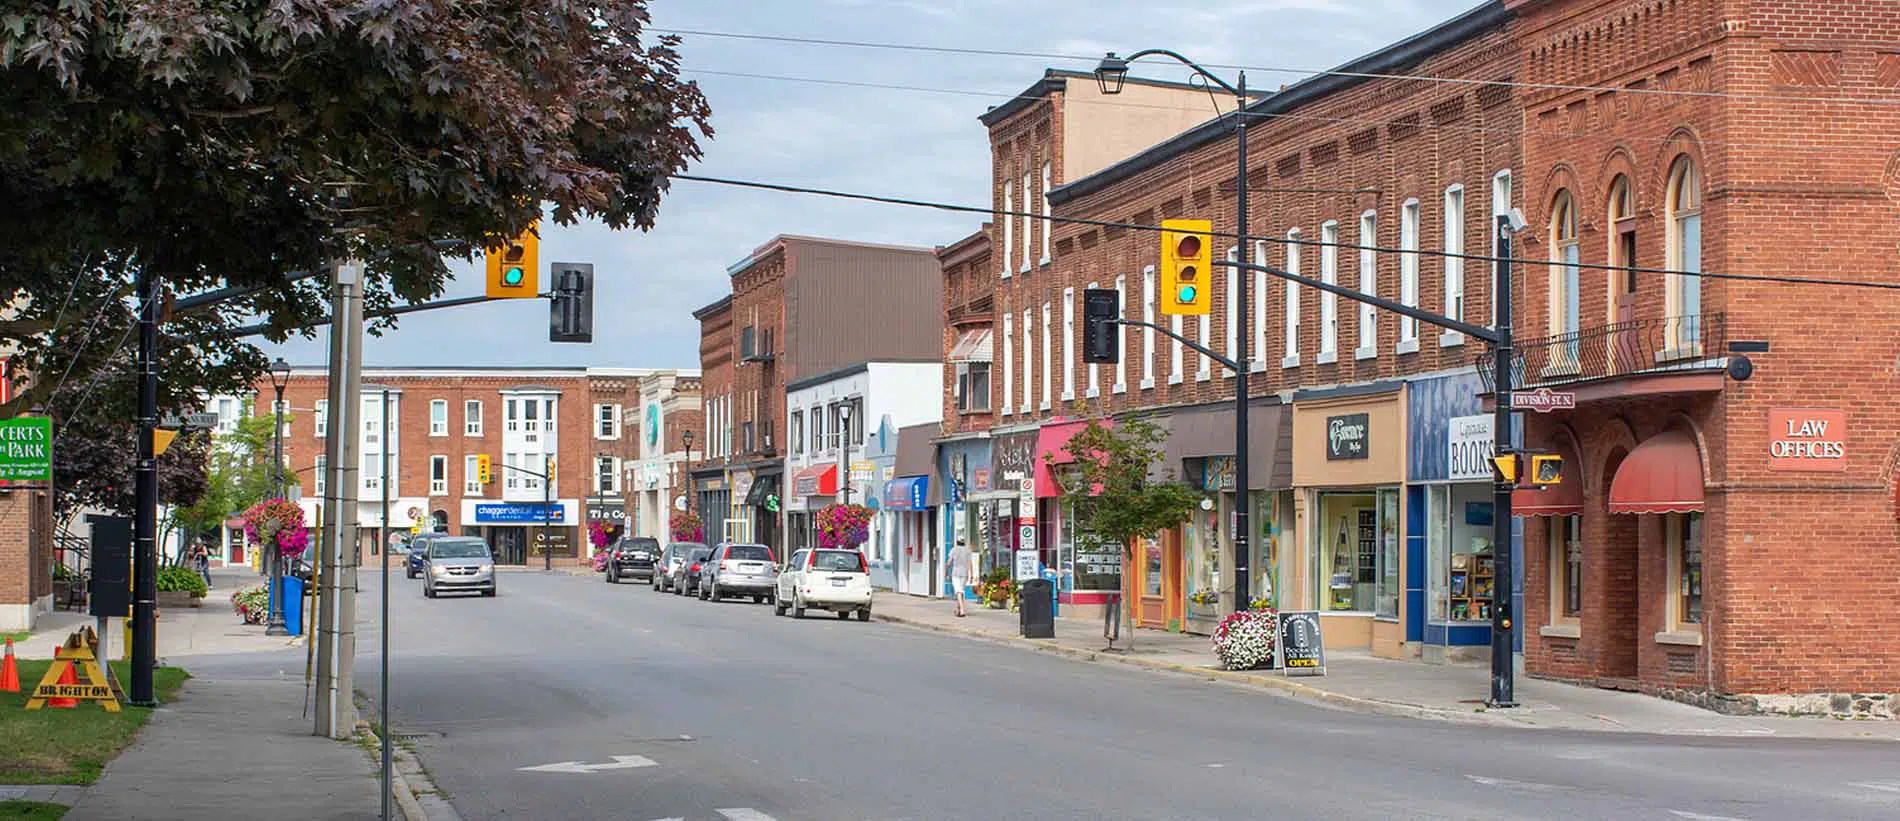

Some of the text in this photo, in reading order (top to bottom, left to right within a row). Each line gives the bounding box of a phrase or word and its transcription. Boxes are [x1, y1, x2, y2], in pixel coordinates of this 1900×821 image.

[1515, 394, 1551, 406] DIVISION
[1551, 394, 1561, 405] ST.
[0, 426, 44, 440] CERTS
[1787, 419, 1829, 437] LAW
[8, 442, 44, 458] PARK
[1770, 440, 1845, 459] OFFICES
[1452, 440, 1494, 475] BOOKS
[18, 468, 45, 476] August
[1289, 659, 1320, 667] OPEN
[40, 686, 108, 697] BRIGHTON
